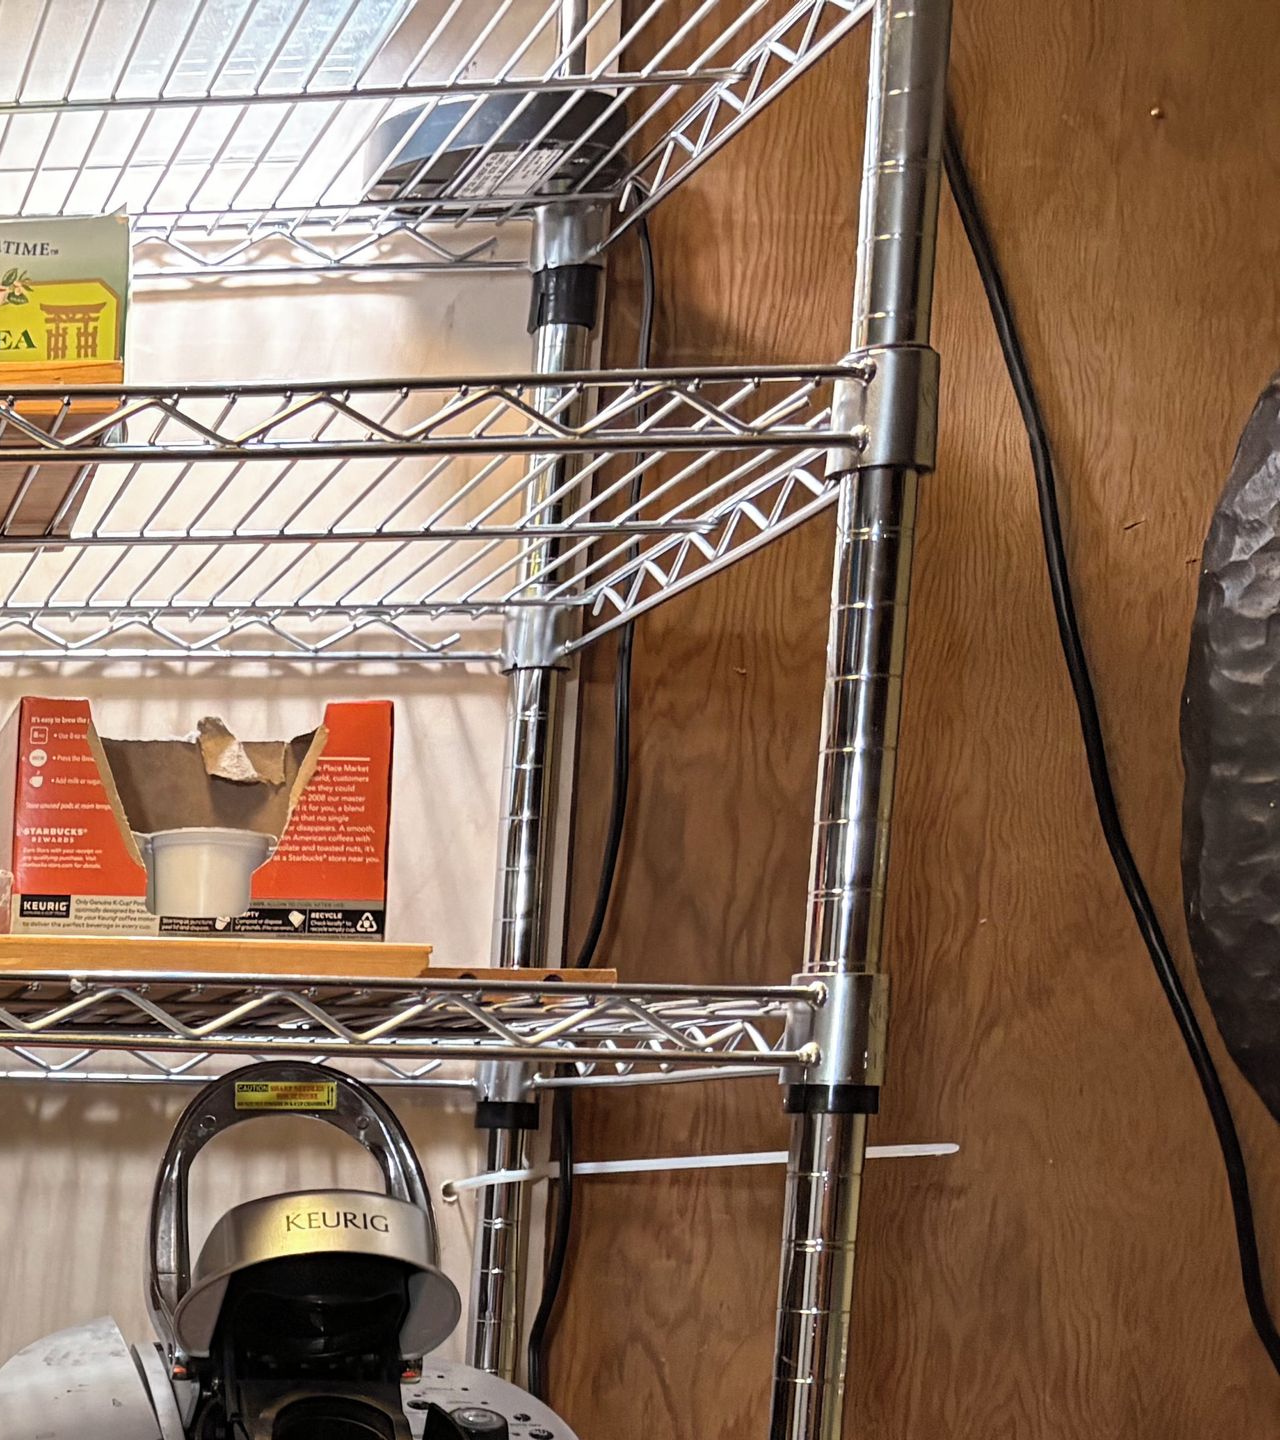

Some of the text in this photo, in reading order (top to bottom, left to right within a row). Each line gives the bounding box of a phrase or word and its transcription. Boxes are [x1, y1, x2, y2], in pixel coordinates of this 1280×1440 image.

[318, 786, 333, 795] they
[328, 815, 349, 823] single
[22, 827, 84, 836] STARBUCKS
[23, 901, 68, 911] KEURIG
[285, 1211, 390, 1233] KEURIG
